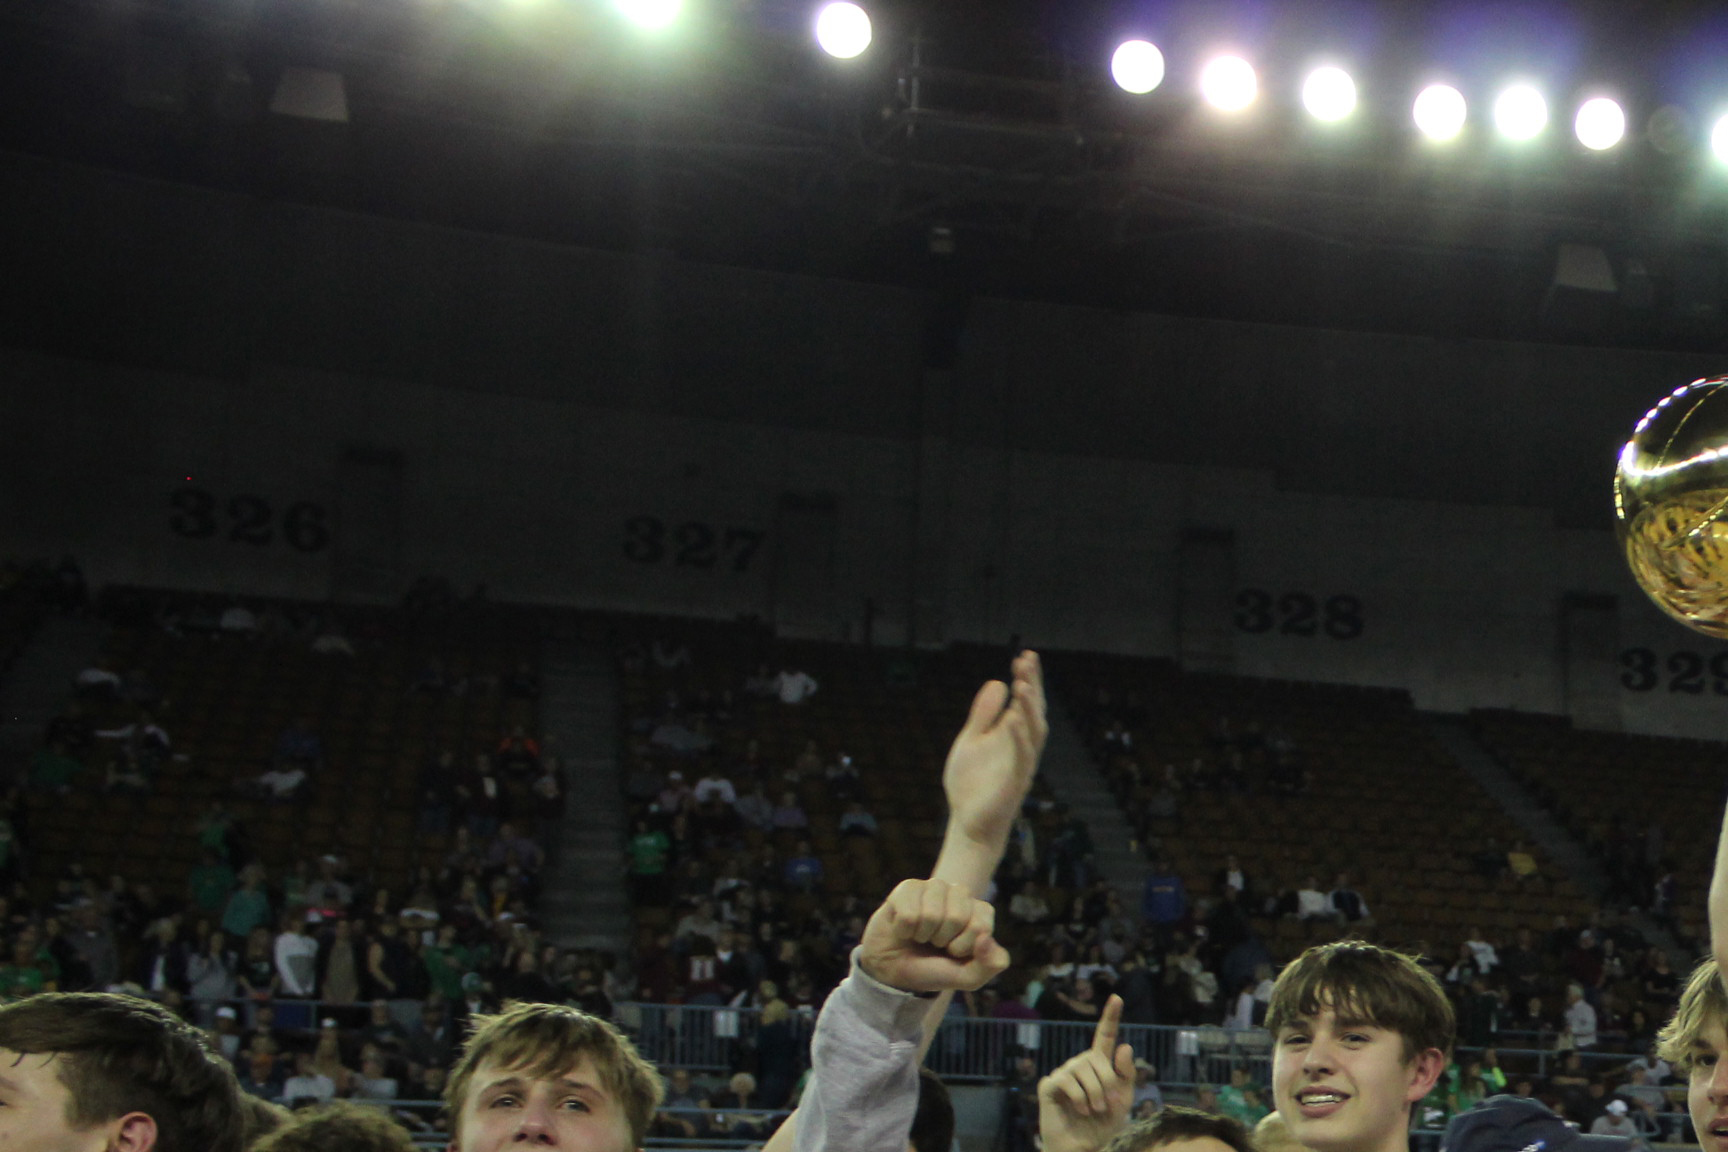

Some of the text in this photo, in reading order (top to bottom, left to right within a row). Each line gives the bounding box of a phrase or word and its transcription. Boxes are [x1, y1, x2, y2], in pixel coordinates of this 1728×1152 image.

[170, 488, 330, 552] 326
[624, 516, 766, 572] 327
[1233, 588, 1363, 640] 328
